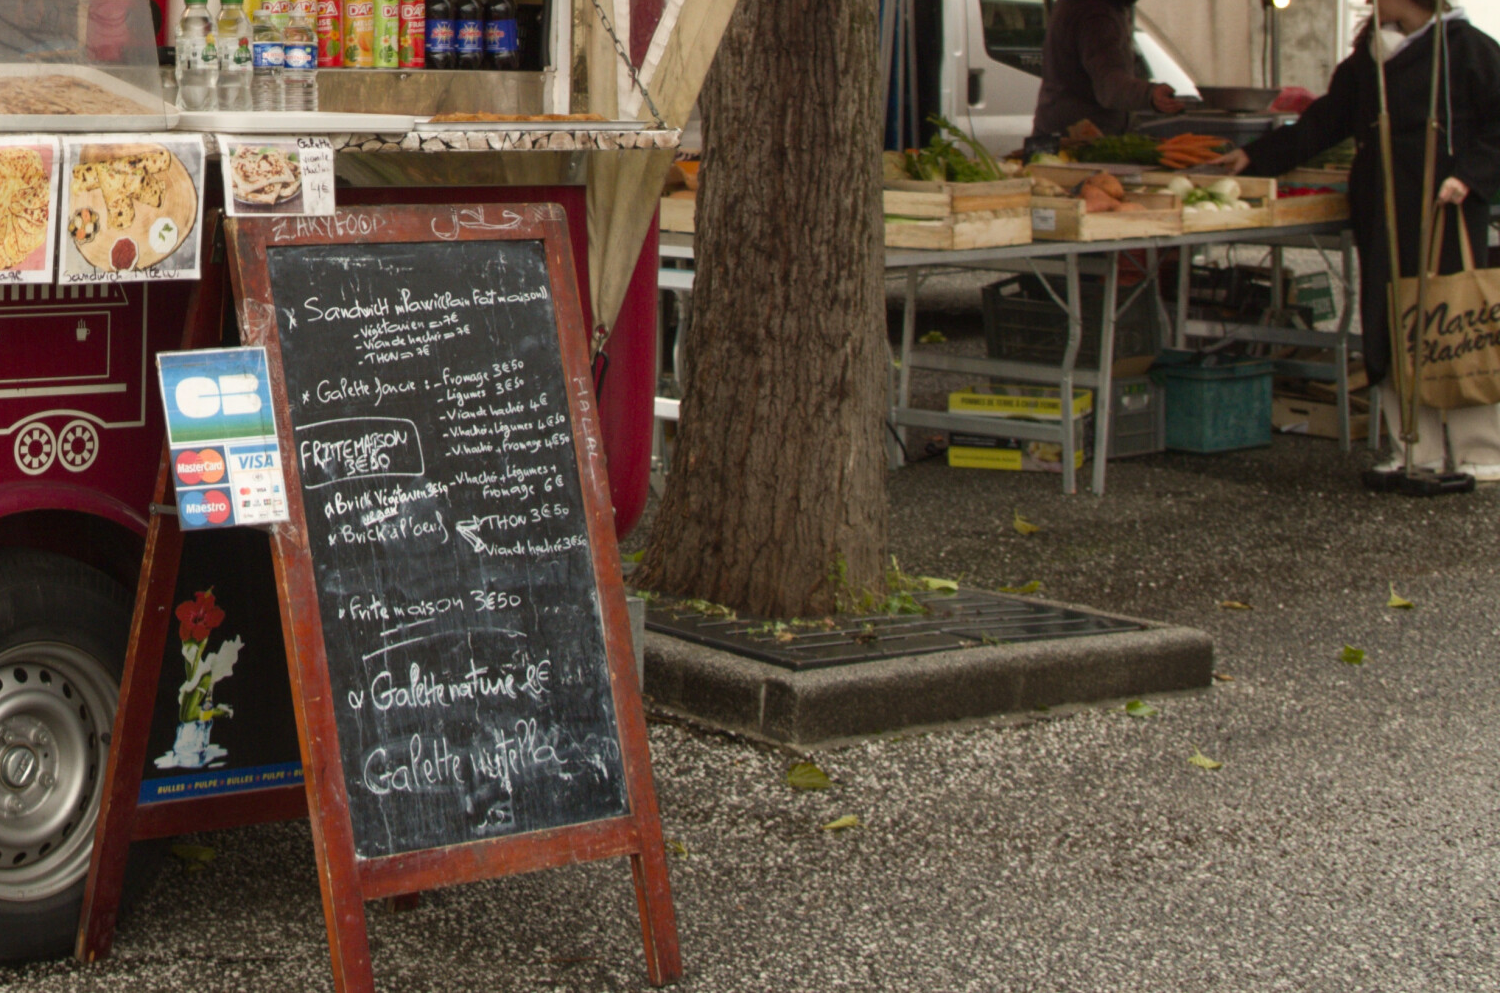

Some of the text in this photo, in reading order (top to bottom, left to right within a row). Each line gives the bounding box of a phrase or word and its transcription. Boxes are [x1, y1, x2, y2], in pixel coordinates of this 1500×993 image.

[177, 459, 223, 475] MasterCard
[238, 454, 274, 470] VISA
[186, 502, 226, 515] Maestro
